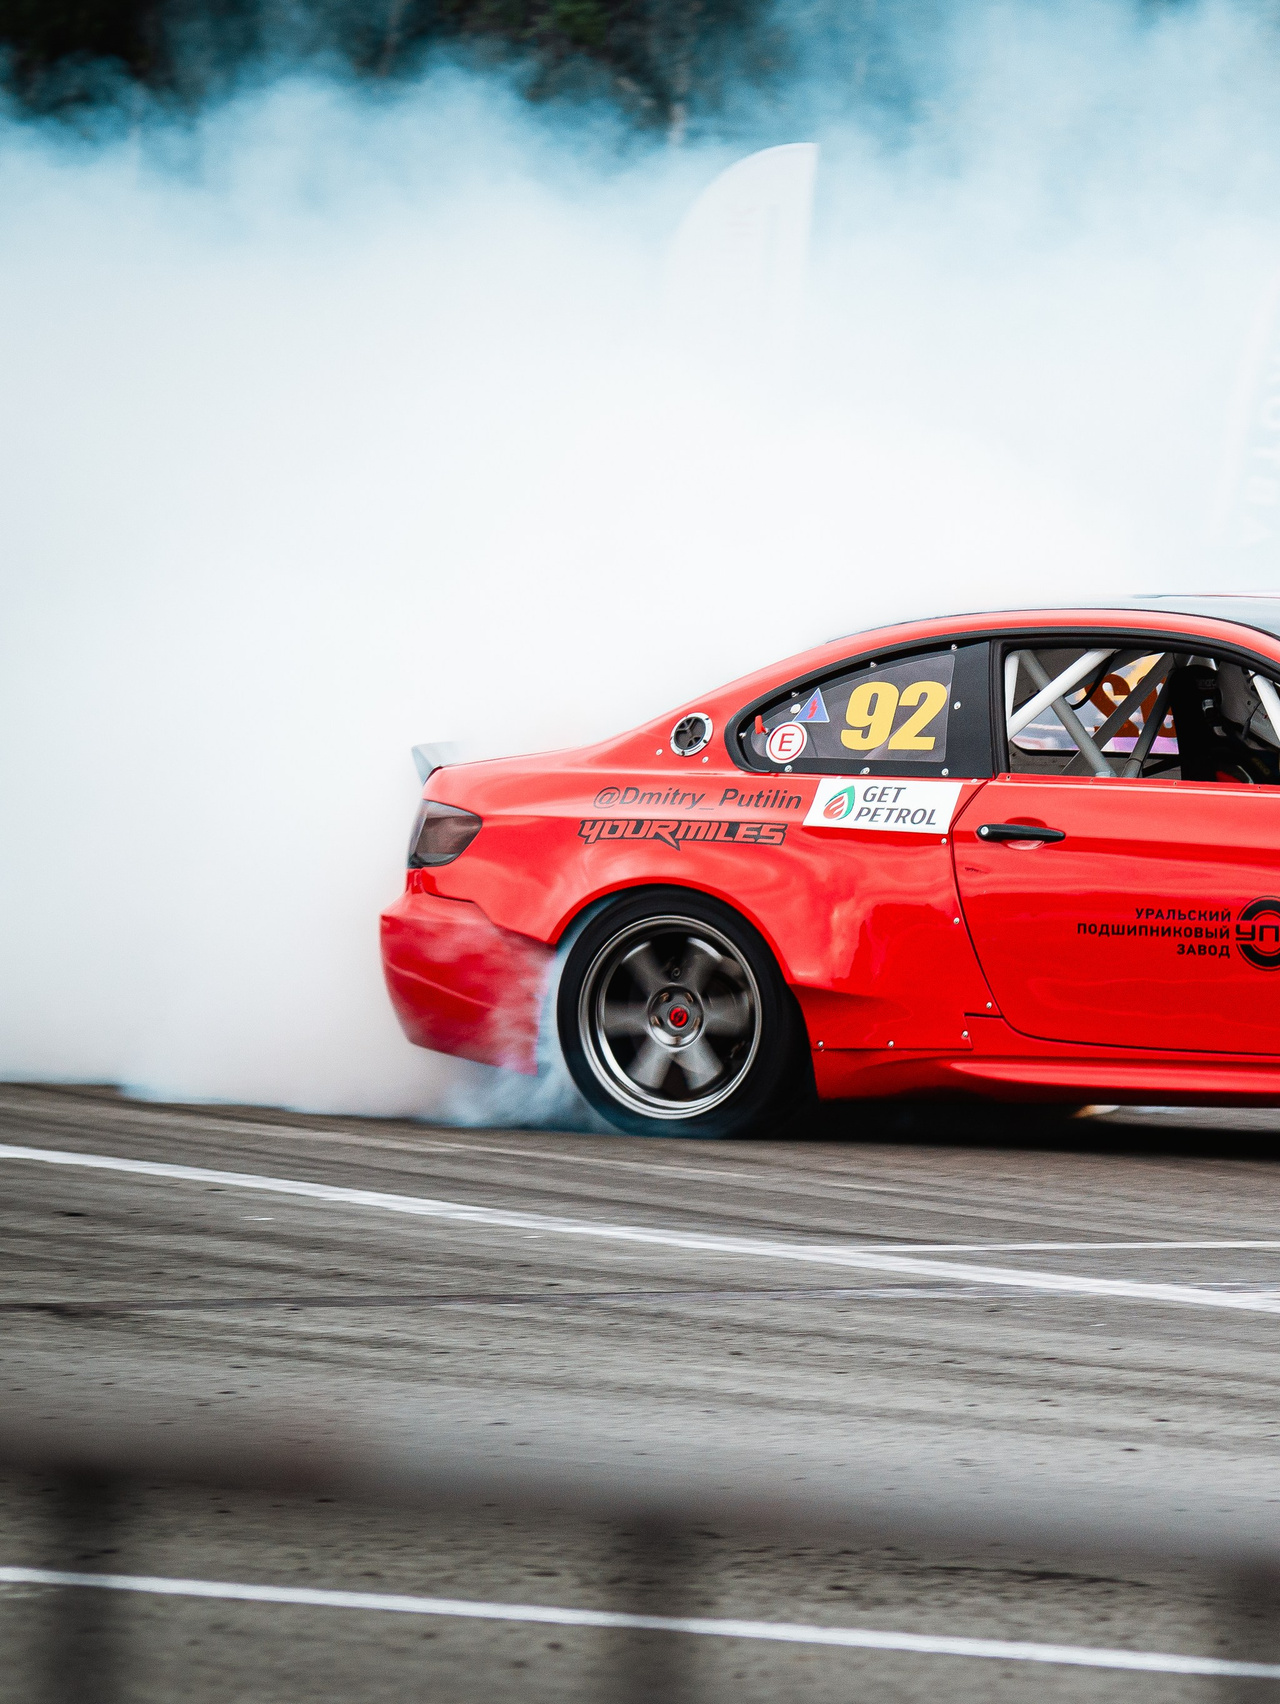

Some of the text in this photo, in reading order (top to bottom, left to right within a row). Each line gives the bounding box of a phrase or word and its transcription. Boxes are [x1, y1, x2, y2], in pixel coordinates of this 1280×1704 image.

[840, 681, 948, 751] 92
[778, 733, 795, 752] E
[593, 785, 803, 811] @Dmitry_Putilin
[863, 786, 907, 804] GET
[854, 806, 937, 826] PETROL
[577, 819, 789, 851] YOURMILES
[1135, 906, 1231, 922] УРАЛЬСКИЙ
[1077, 922, 1230, 940] ПОДШИПНИКОВЫЙ
[1176, 942, 1231, 959] ЗАВОД
